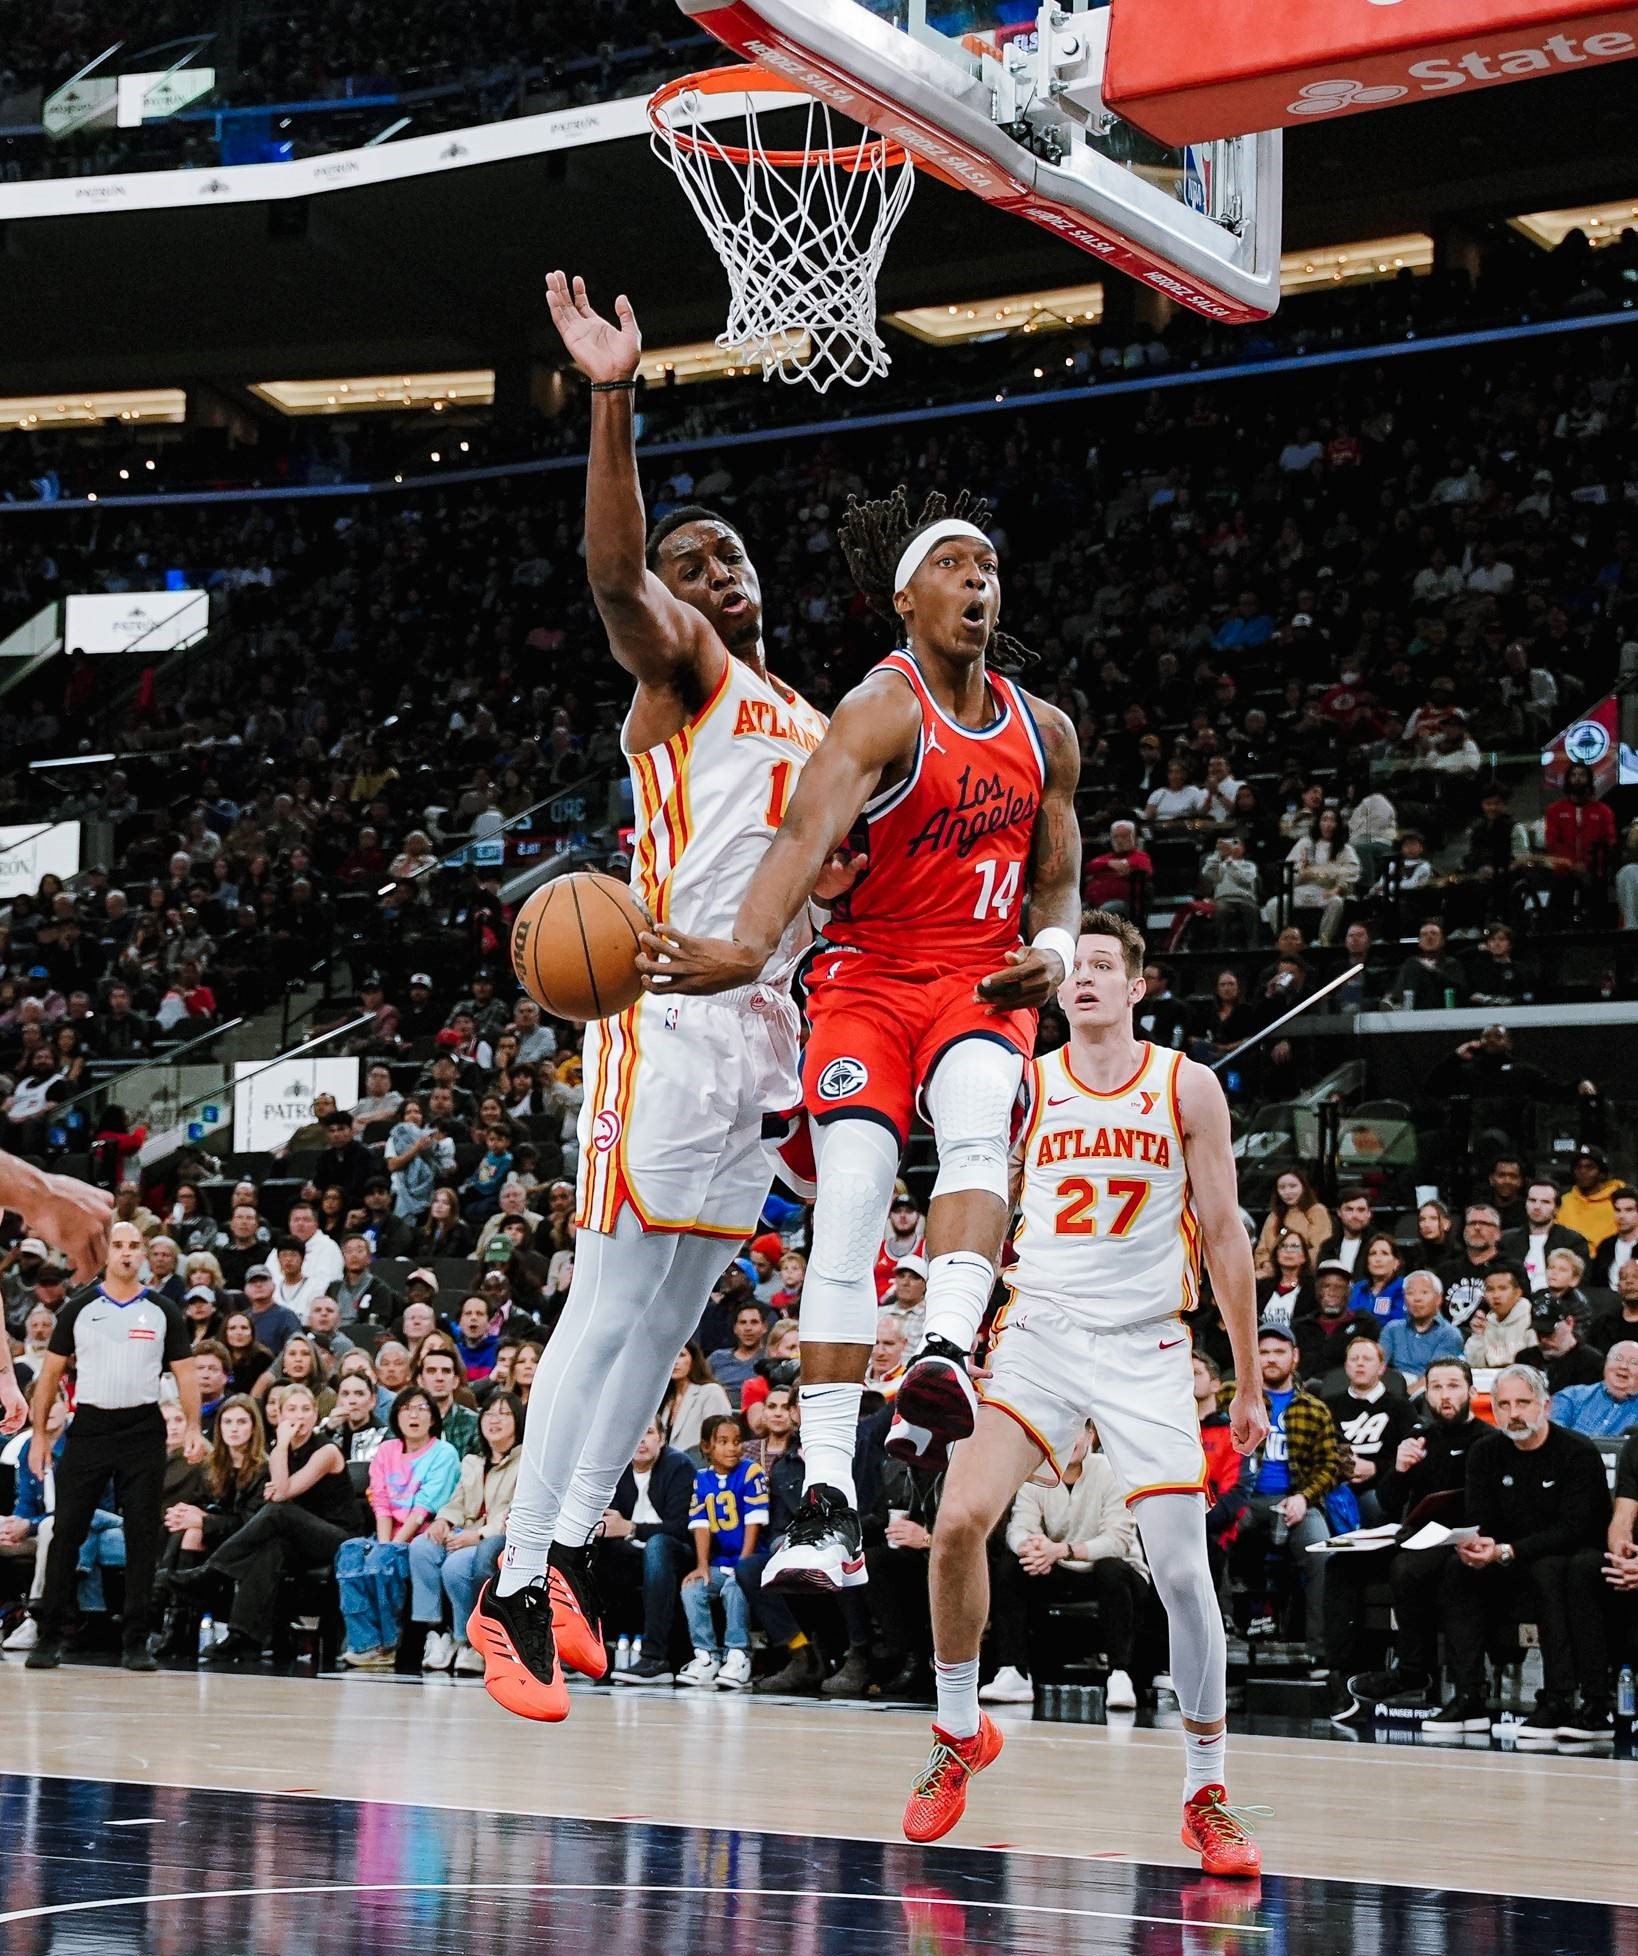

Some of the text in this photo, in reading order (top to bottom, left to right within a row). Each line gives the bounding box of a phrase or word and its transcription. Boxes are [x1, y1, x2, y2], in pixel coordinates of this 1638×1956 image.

[743, 39, 855, 103] HERDEZ SALSA
[1408, 32, 1636, 91] State
[889, 126, 993, 189] HERDEZ SALSA
[1023, 208, 1117, 255] HERDEZ SALSA
[1143, 270, 1231, 318] HERDEZ SALSA
[732, 699, 822, 754] ATLAN
[956, 764, 1006, 812] Los
[906, 785, 1036, 859] Angeles
[973, 859, 1022, 920] 14
[1036, 1126, 1170, 1169] ATLANTA
[1055, 1176, 1151, 1236] 27
[704, 1490, 739, 1533] 13
